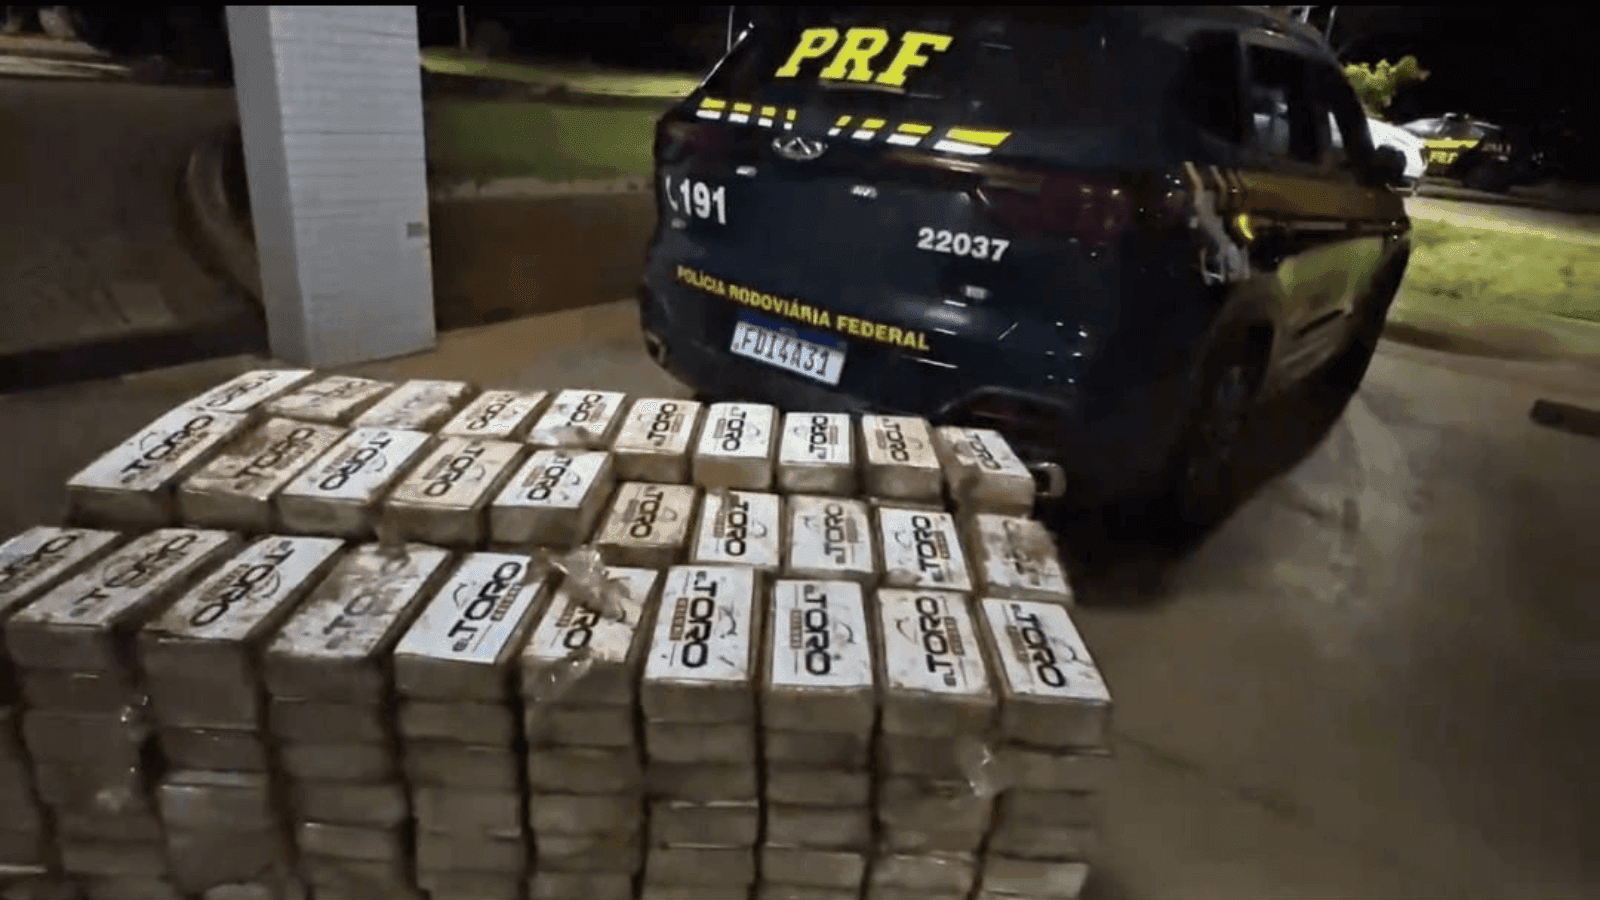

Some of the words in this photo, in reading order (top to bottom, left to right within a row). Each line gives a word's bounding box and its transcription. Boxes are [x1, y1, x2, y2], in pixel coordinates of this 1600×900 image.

[775, 27, 953, 86] PRF
[680, 177, 727, 225] 191
[917, 227, 1010, 262] 22037
[677, 264, 726, 295] POLÍCIA
[728, 284, 830, 328] RODOVIÁRIA
[836, 315, 930, 350] FEDERAL
[722, 411, 746, 451] TORO
[809, 415, 829, 453] TORO
[886, 422, 910, 462] TORO
[911, 515, 941, 573] TORO
[448, 561, 522, 638] TORO
[681, 581, 717, 668] TORO
[804, 593, 831, 675] TORO
[915, 596, 952, 673] TORO
[1021, 612, 1066, 688] TORO
